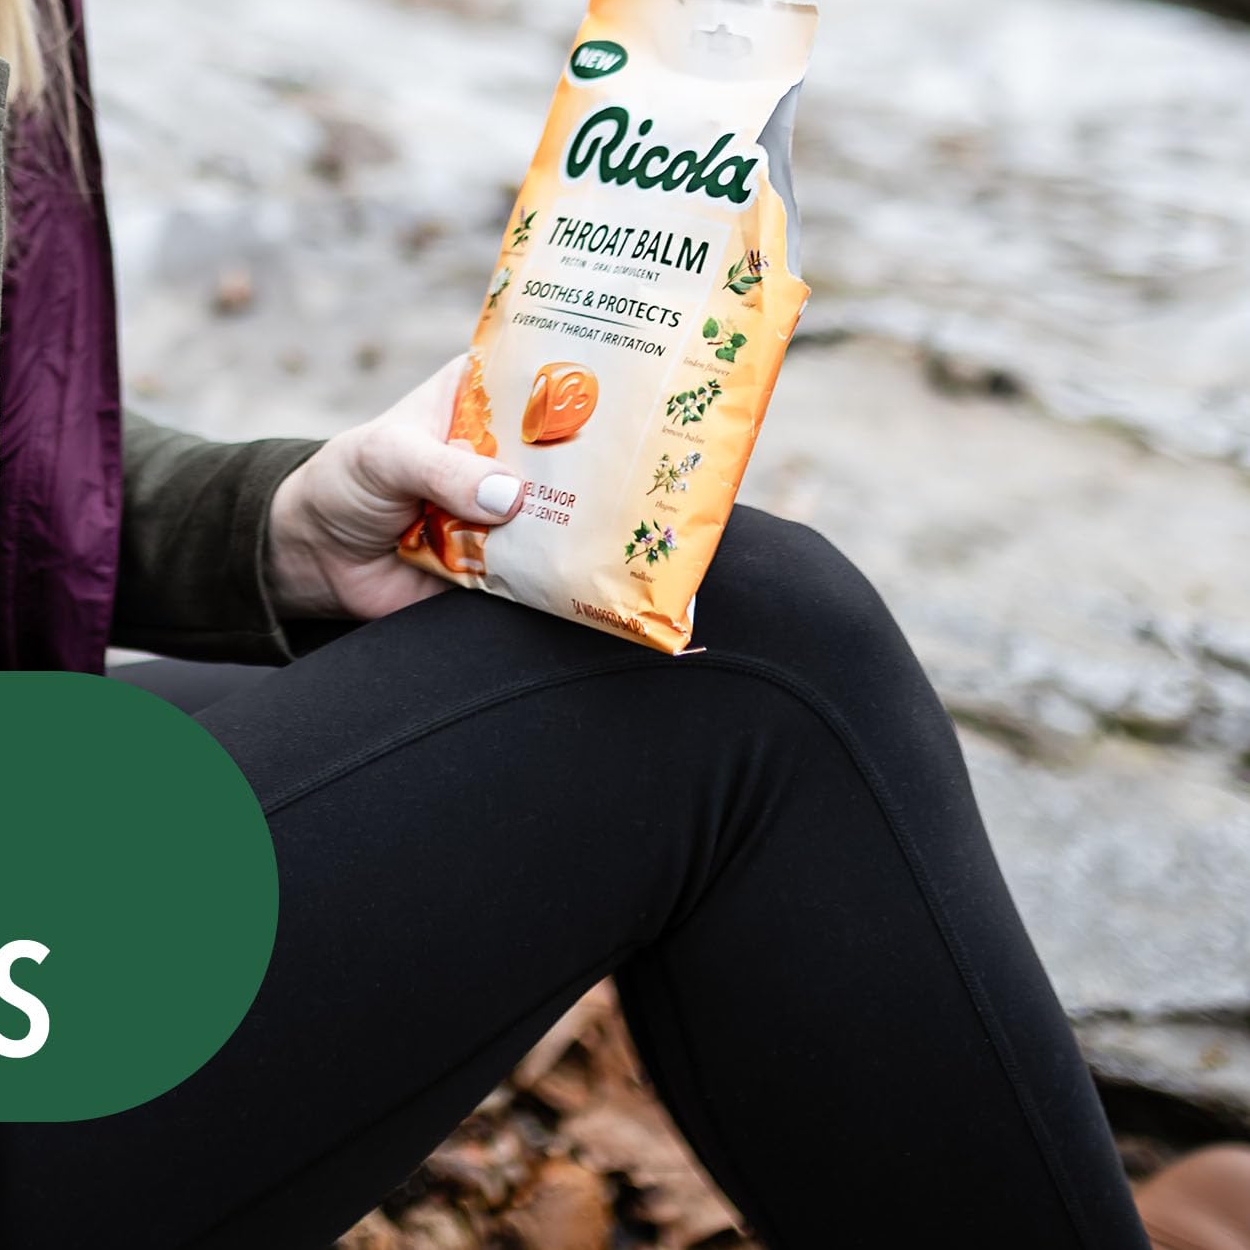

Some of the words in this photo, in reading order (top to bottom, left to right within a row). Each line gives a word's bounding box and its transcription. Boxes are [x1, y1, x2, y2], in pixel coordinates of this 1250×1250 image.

[575, 47, 622, 71] NEW
[566, 106, 758, 204] Ricola
[549, 217, 635, 257] THROAT
[630, 230, 709, 274] BALM
[522, 280, 583, 304] SOOTHES
[583, 290, 594, 307] &
[597, 294, 682, 327] PROTECTS
[512, 312, 559, 330] EVERYDAY
[560, 322, 600, 341] THROAT
[600, 332, 666, 357] IRRITATION
[535, 506, 571, 526] CENTER
[538, 485, 576, 508] FLAVOR
